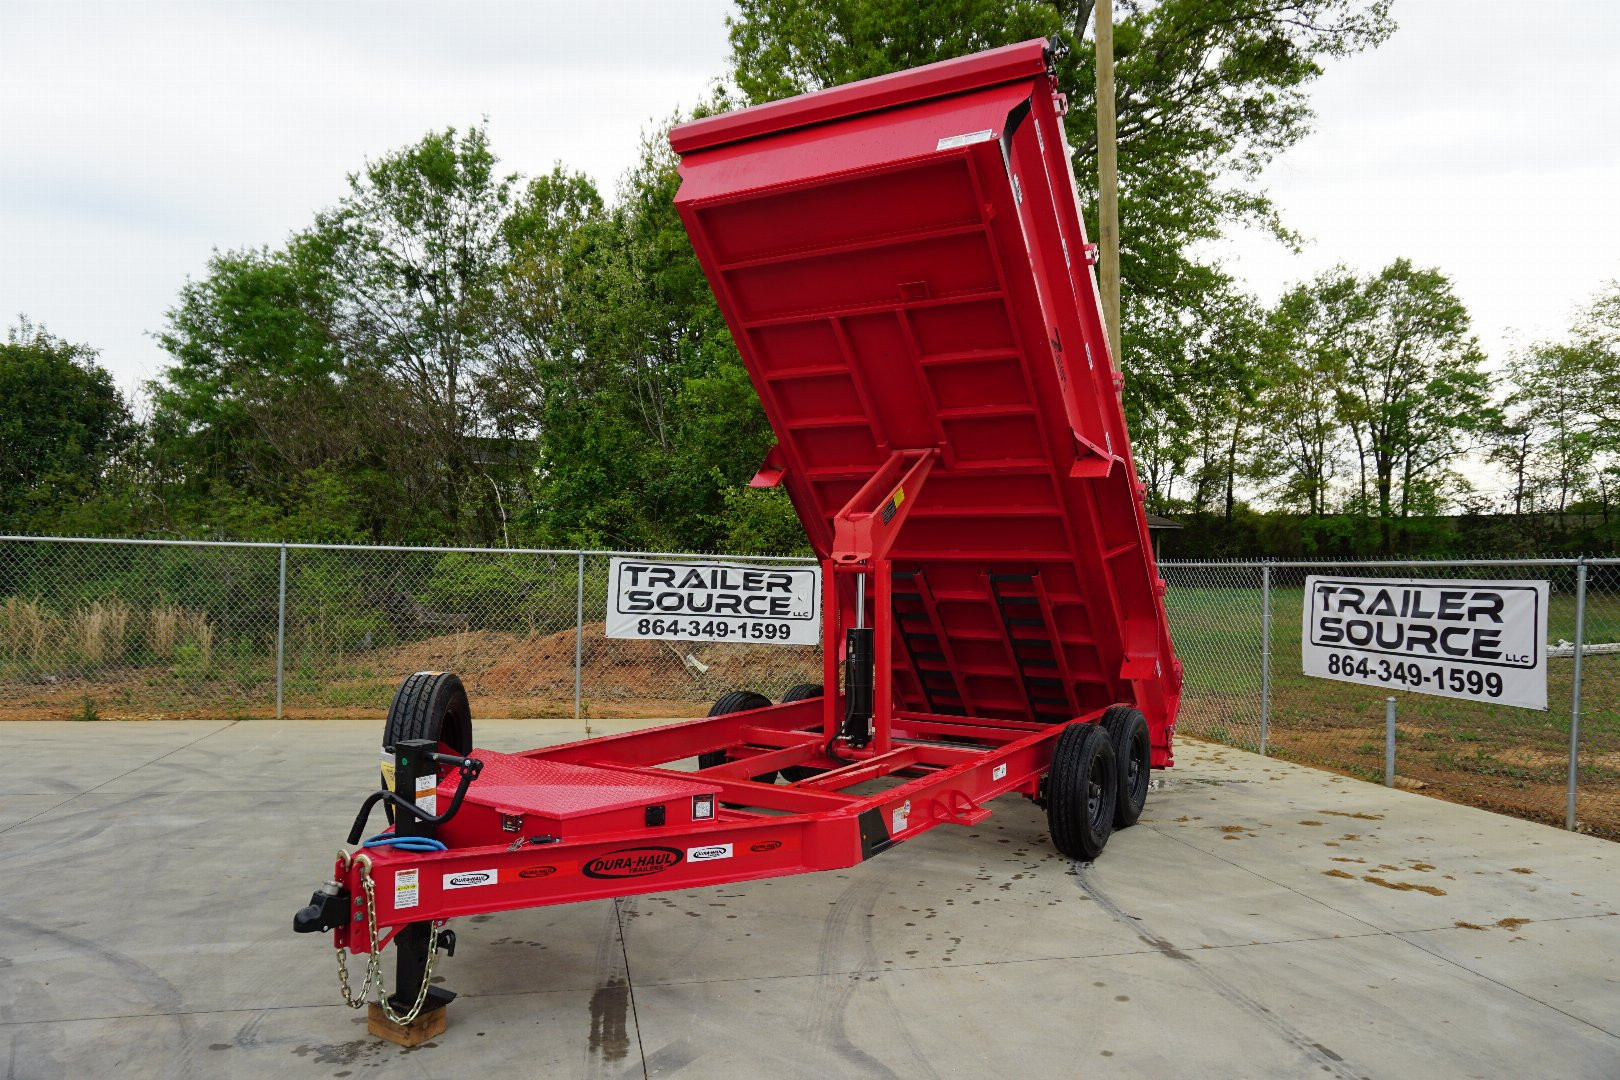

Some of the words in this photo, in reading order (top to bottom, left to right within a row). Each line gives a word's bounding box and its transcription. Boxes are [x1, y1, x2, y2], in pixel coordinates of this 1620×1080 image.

[624, 566, 793, 593] TRAILER
[627, 590, 792, 616] SOURCE
[1316, 586, 1504, 623] TRAILER
[637, 618, 791, 640] 864-349-1599
[1319, 616, 1503, 660] SOURCE
[1505, 653, 1530, 664] LLC
[1328, 653, 1504, 698] 864-349-1599
[594, 854, 673, 872] DURA-HAUL
[628, 865, 664, 874] TRAILERS
